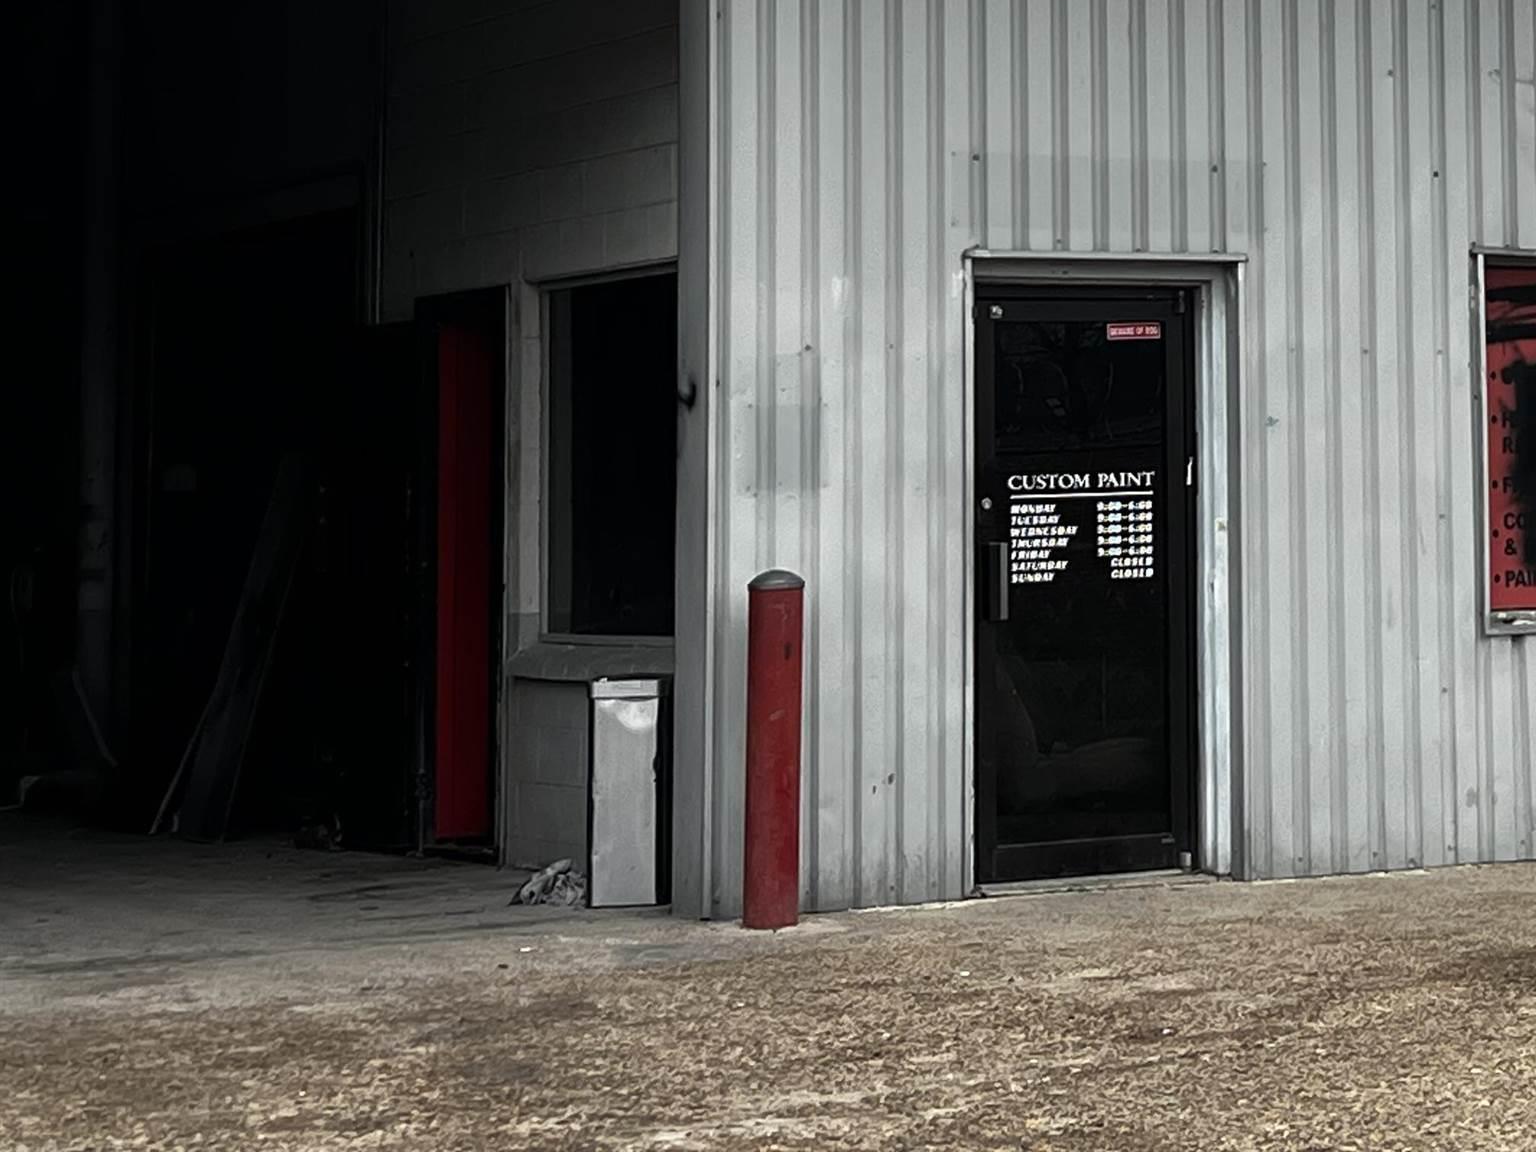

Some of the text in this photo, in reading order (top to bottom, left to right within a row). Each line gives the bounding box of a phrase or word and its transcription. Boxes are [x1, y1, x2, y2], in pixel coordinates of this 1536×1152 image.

[1007, 471, 1156, 490] CUSTOM PAINT
[1010, 503, 1056, 514] MONDAY
[1010, 514, 1061, 526] TUESDAY
[1010, 525, 1078, 537] WEDNESDAY
[1010, 537, 1069, 549] THURSDAY
[1010, 549, 1051, 560] FRIDAY
[1010, 556, 1154, 572] SATURDAY CLOSED
[1010, 568, 1154, 583] SUNDAY CLOSED
